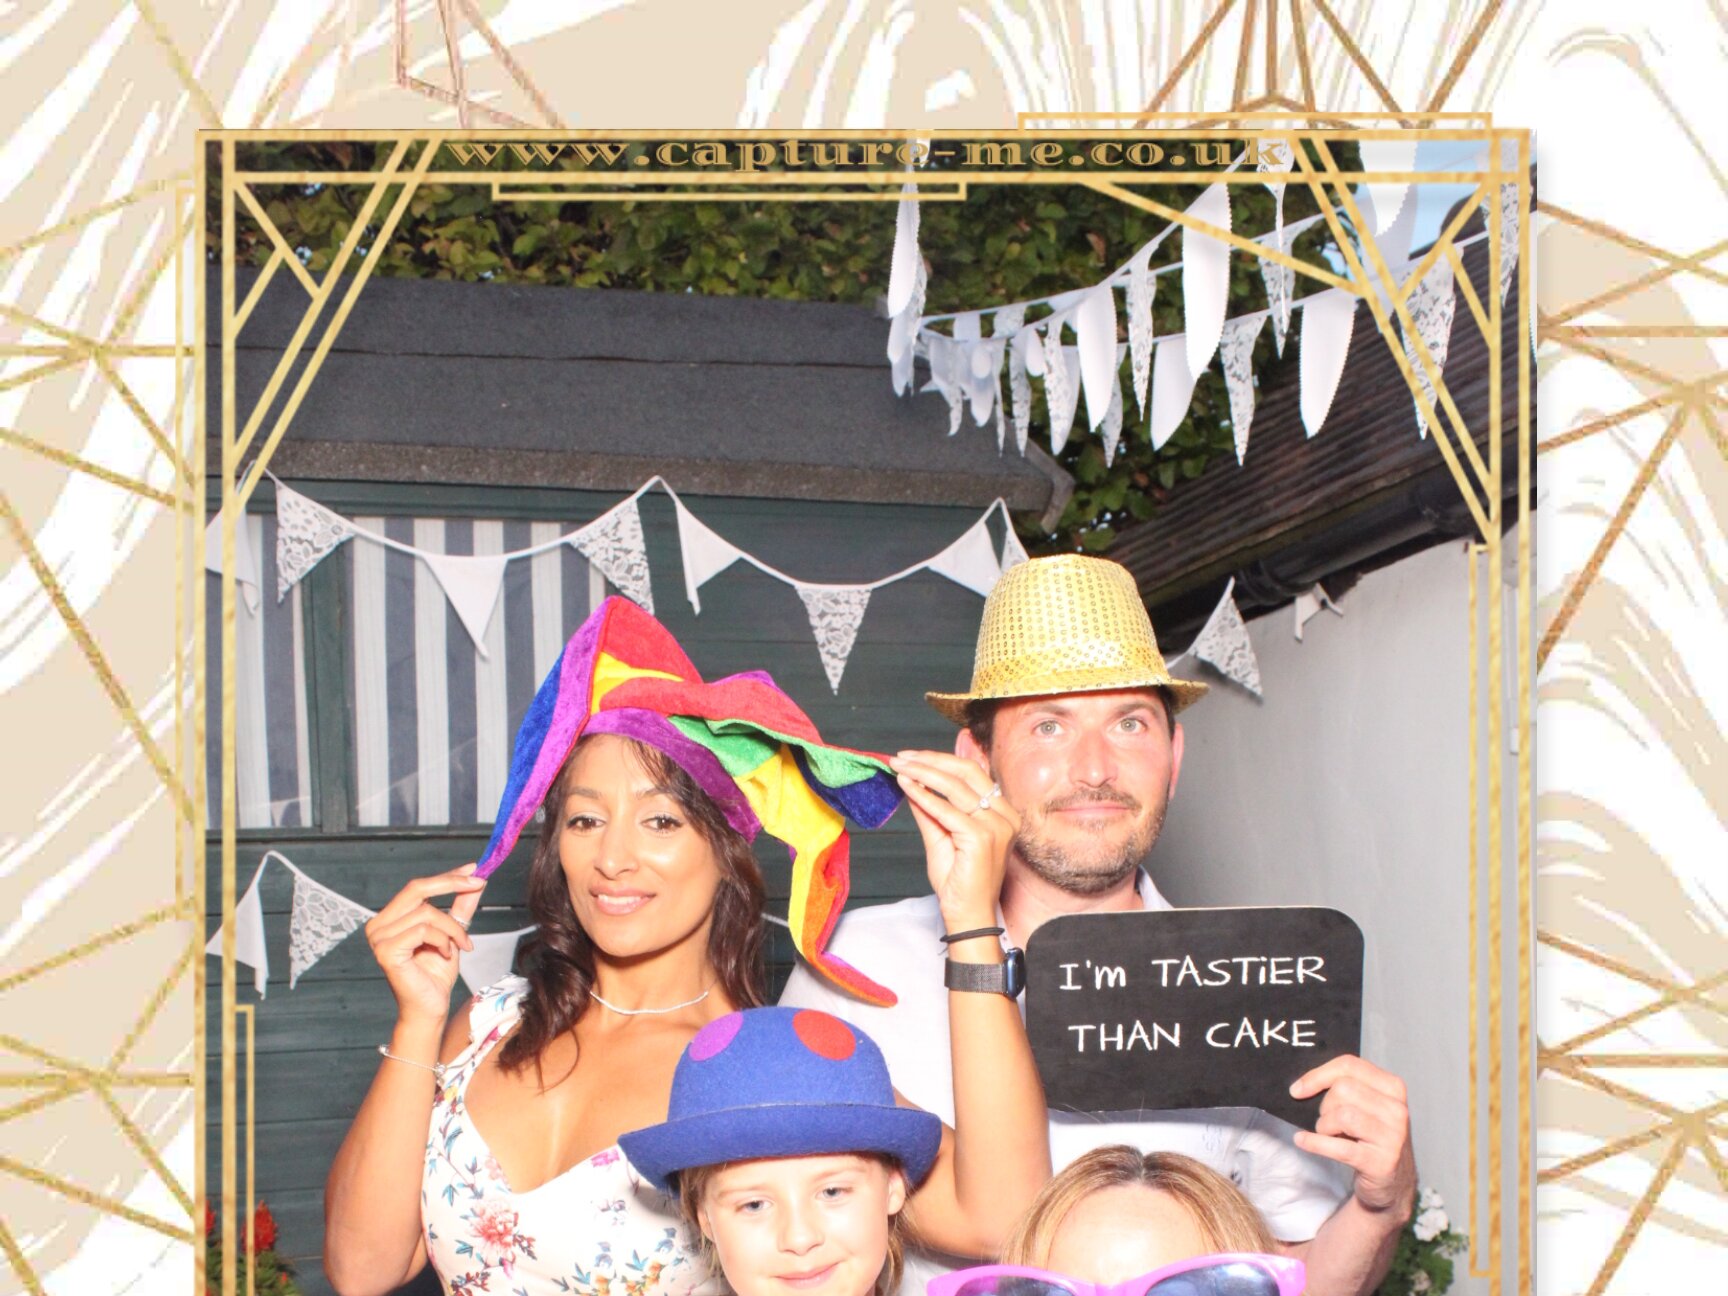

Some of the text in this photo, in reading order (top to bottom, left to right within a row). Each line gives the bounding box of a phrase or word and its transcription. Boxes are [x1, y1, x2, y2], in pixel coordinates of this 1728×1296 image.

[1059, 960, 1127, 991] I'm
[1067, 1016, 1317, 1052] THAN CAKE
